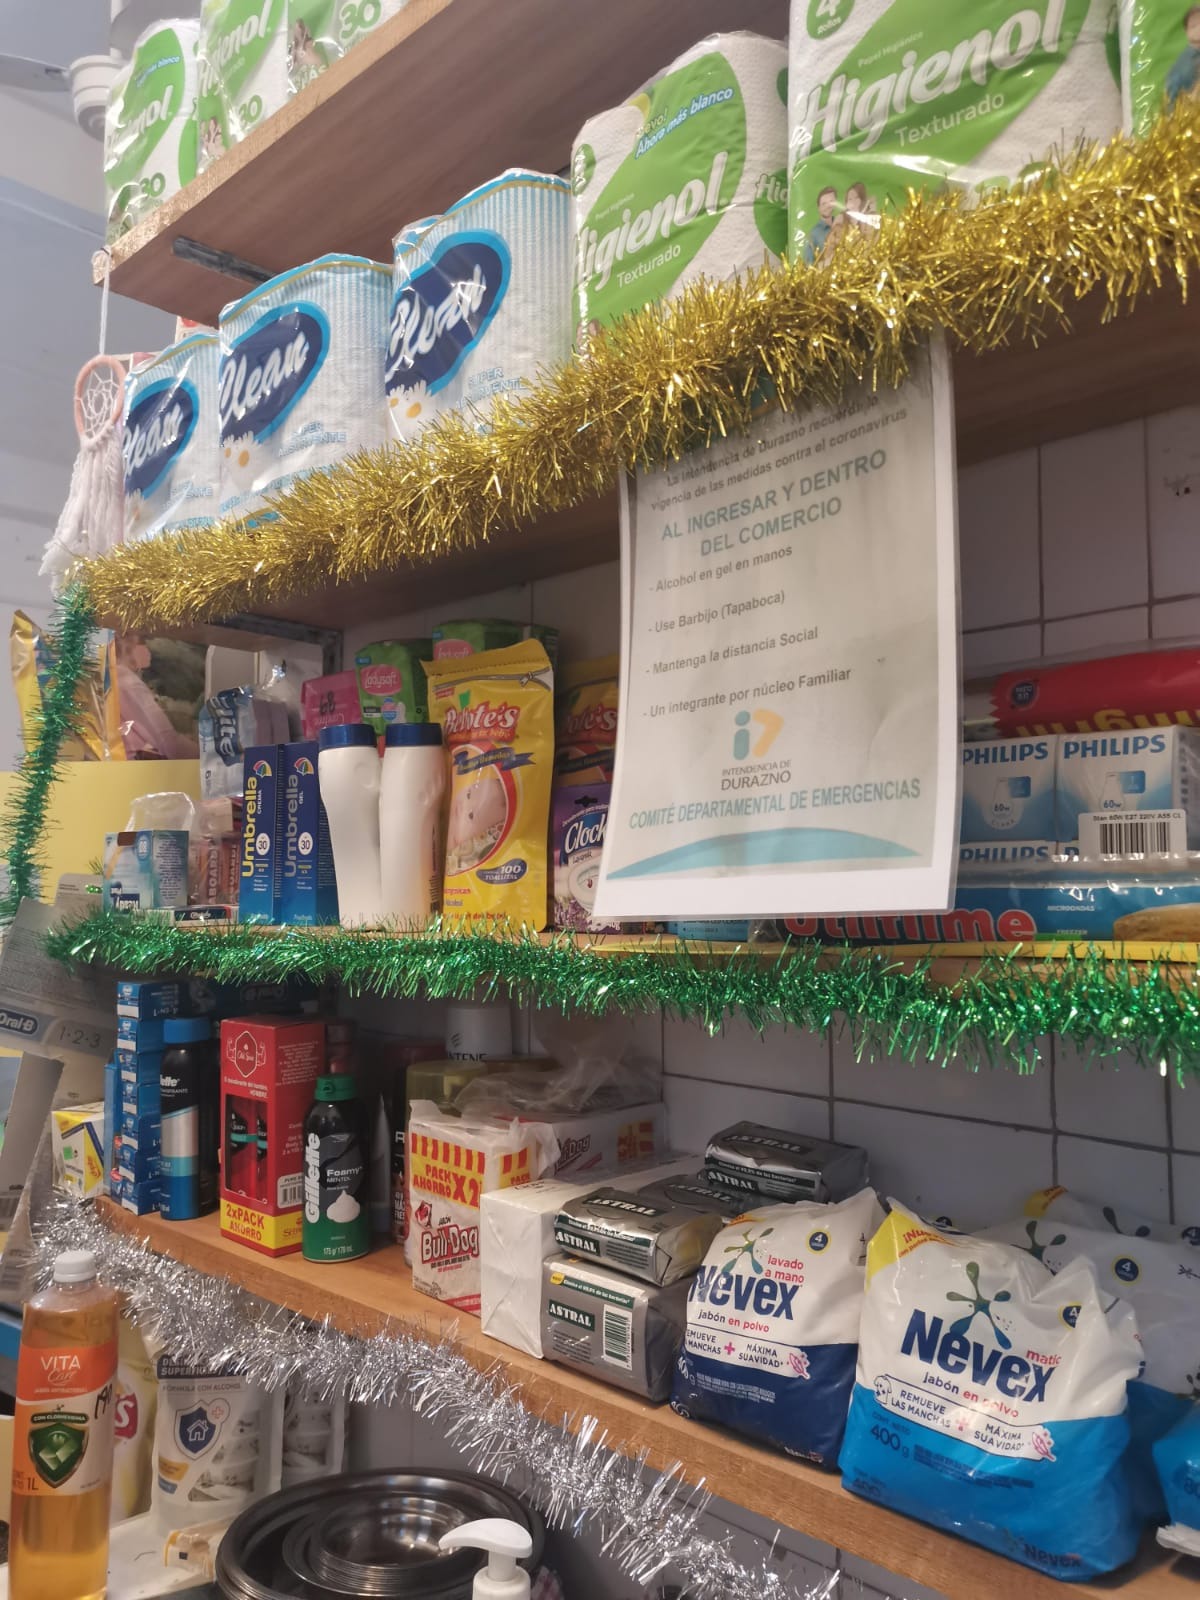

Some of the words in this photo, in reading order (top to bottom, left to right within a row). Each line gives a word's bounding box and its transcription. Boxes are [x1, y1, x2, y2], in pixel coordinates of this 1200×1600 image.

[690, 87, 734, 116] blanco
[895, 93, 1006, 149] Texturado
[616, 243, 681, 289] Texturado
[651, 491, 692, 513] vigencia
[694, 484, 707, 499] de
[709, 477, 725, 493] las
[726, 463, 772, 488] medidas
[775, 447, 813, 470] contra
[815, 439, 827, 454] el
[828, 409, 908, 448] coronavirus
[682, 454, 740, 484] Intendencia
[661, 523, 684, 542] AL
[687, 489, 777, 535] INGRESAR
[781, 482, 796, 503] Y
[799, 448, 888, 498] DENTRO
[700, 535, 736, 558] DEL
[738, 496, 843, 545] COMERCIO
[655, 571, 698, 593] Alcohol
[699, 567, 714, 582] en
[715, 560, 734, 581] gel
[735, 558, 750, 573] en
[752, 546, 793, 567] manos
[654, 619, 676, 634] Use
[678, 608, 719, 630] Barbijo
[721, 590, 786, 620] (Tapaboca)
[652, 652, 707, 676] Mantenga
[709, 649, 720, 663] la
[722, 636, 777, 661] distancia
[779, 625, 820, 649] Social
[649, 703, 666, 719] Un
[668, 691, 726, 715] integrante
[729, 688, 750, 706] por
[752, 677, 796, 700] núcleo
[798, 667, 852, 690] Familiar
[962, 741, 1049, 767] PHILIPS
[1063, 734, 1167, 760] PHILIPS
[720, 769, 792, 792] DURAZNO
[721, 761, 778, 777] INTENDENCIA
[779, 758, 792, 770] DE
[628, 801, 676, 830] COMITÉ
[677, 791, 786, 822] DEPARTAMENTAL
[789, 789, 808, 811] DE
[810, 777, 921, 811] EMERGENCIAS
[241, 776, 258, 878] Umbrella
[284, 774, 299, 878] Umbrella
[257, 839, 268, 851] 30
[300, 839, 311, 851] 30
[500, 865, 522, 875] 100
[304, 1132, 320, 1224] Gillette
[412, 1173, 452, 1199] AHORRO
[425, 1163, 451, 1185] PACK
[226, 1204, 265, 1230] 2xPACK
[230, 1221, 262, 1241] AHORRO
[555, 1231, 597, 1253] ASTRAL
[813, 1232, 824, 1243] 4
[767, 1254, 804, 1271] lavado
[1121, 1261, 1132, 1273] 4
[765, 1269, 773, 1279] a
[774, 1270, 805, 1284] mano
[689, 1265, 801, 1321] Nevex
[549, 1303, 592, 1328] ASTRAL
[698, 1309, 726, 1324] jabón
[728, 1316, 741, 1327] en
[743, 1319, 770, 1334] polvo
[686, 1329, 717, 1344] EMUEVE
[688, 1340, 722, 1355] MANCHAS
[40, 1354, 82, 1371] VITA
[900, 1308, 1056, 1405] Nevex
[1025, 1349, 1063, 1367] matic
[922, 1371, 960, 1396] jabón
[962, 1390, 979, 1404] en
[890, 1397, 906, 1411] LAS
[907, 1404, 951, 1429] MANCHAS
[900, 1389, 947, 1416] REMUEVE
[870, 1423, 901, 1452] 400
[984, 1420, 1023, 1441] MÁXIMA
